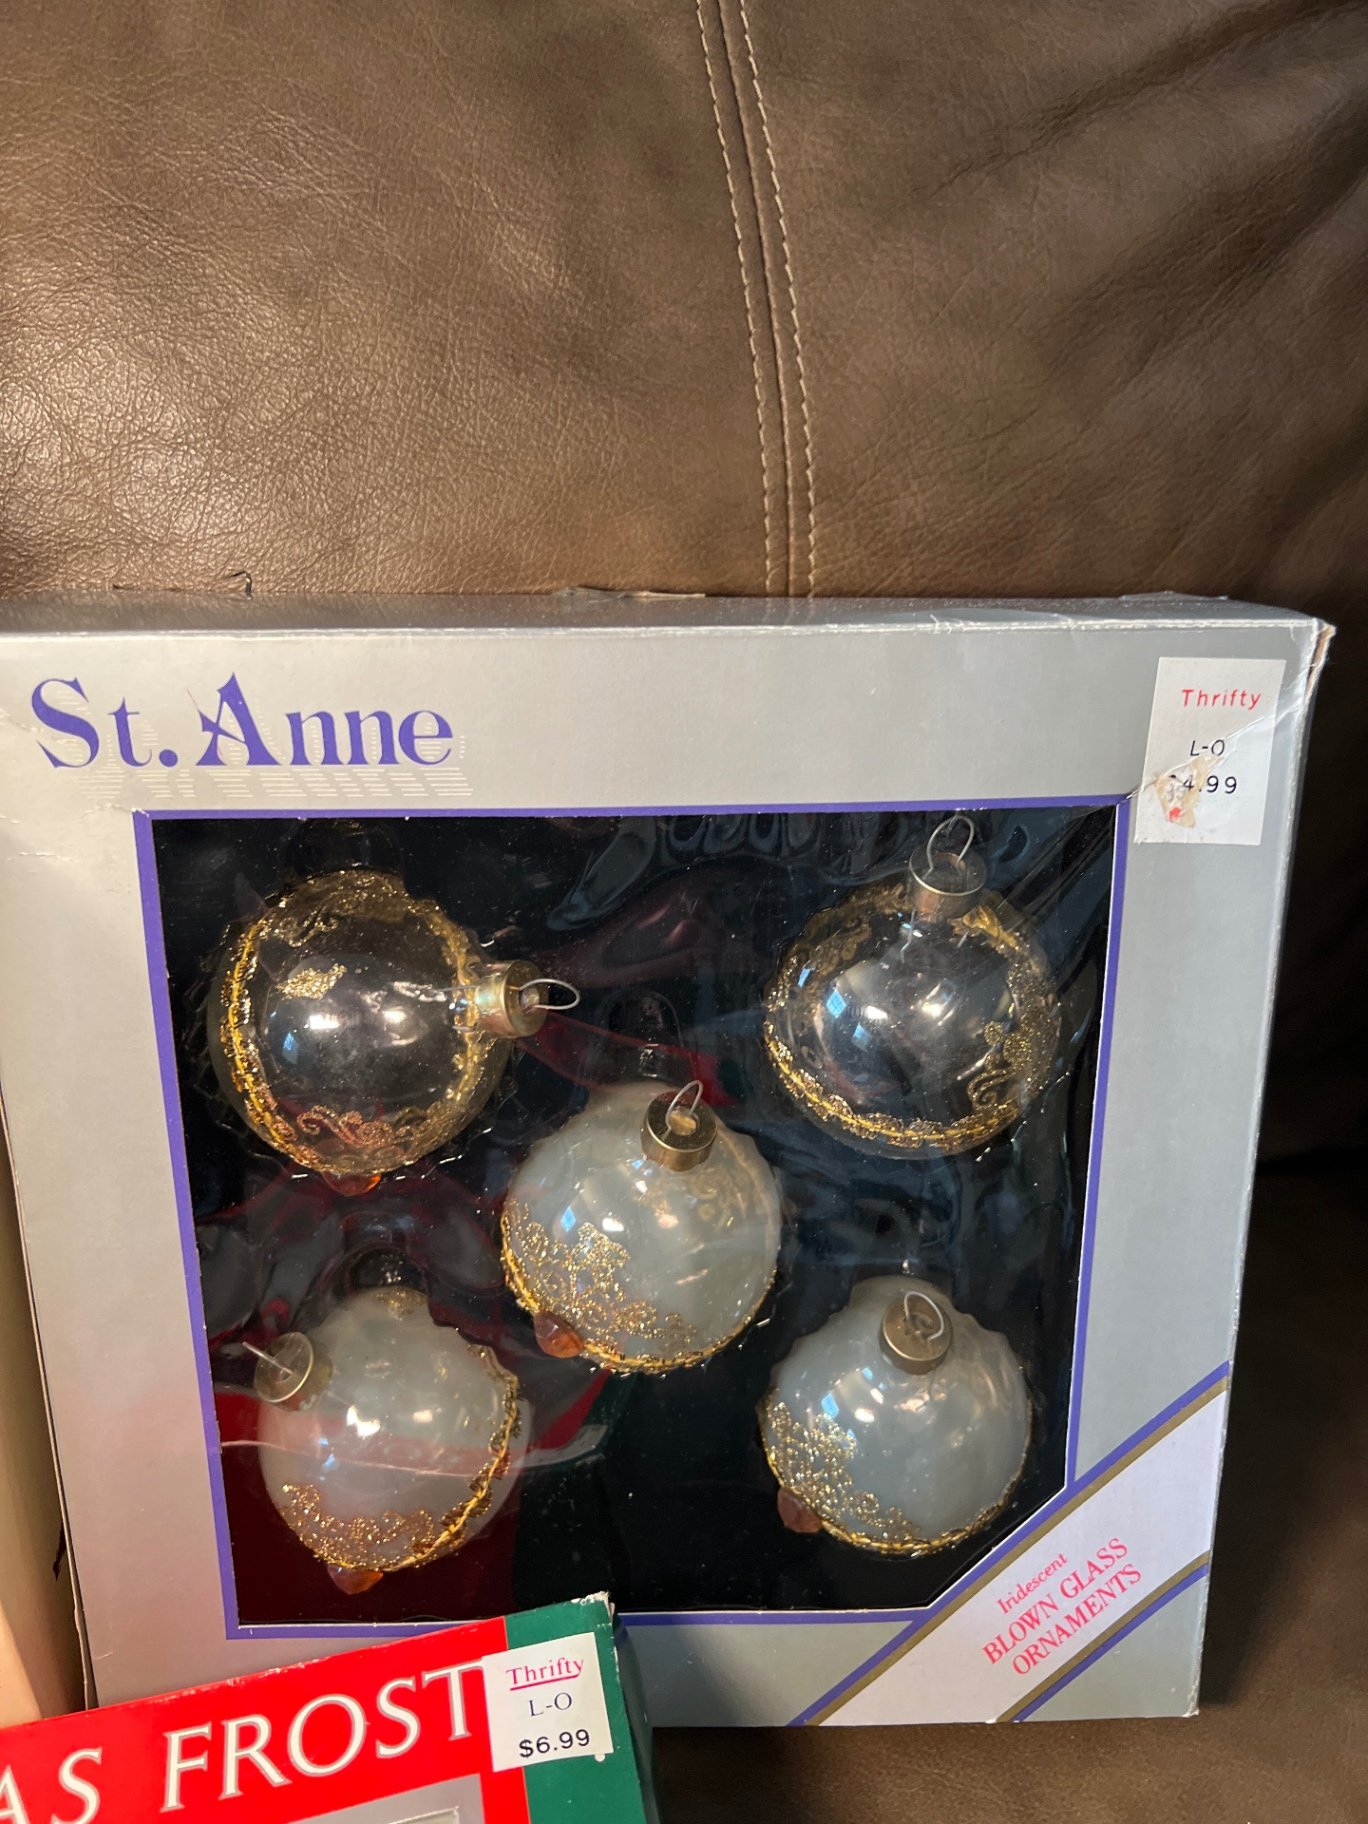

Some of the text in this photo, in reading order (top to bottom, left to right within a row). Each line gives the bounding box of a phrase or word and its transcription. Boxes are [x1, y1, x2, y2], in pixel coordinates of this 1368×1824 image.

[31, 671, 454, 768] St. Anne
[1181, 688, 1262, 710] Thrifty
[1168, 774, 1238, 795] 4.99
[981, 1537, 1129, 1665] BLOWN GLASS
[996, 1553, 1069, 1615] Iridescent
[1012, 1563, 1143, 1676] ORNAMENTS
[505, 1657, 585, 1687] Thrifty
[159, 1658, 486, 1813] FROST
[519, 1728, 591, 1759] $6.99
